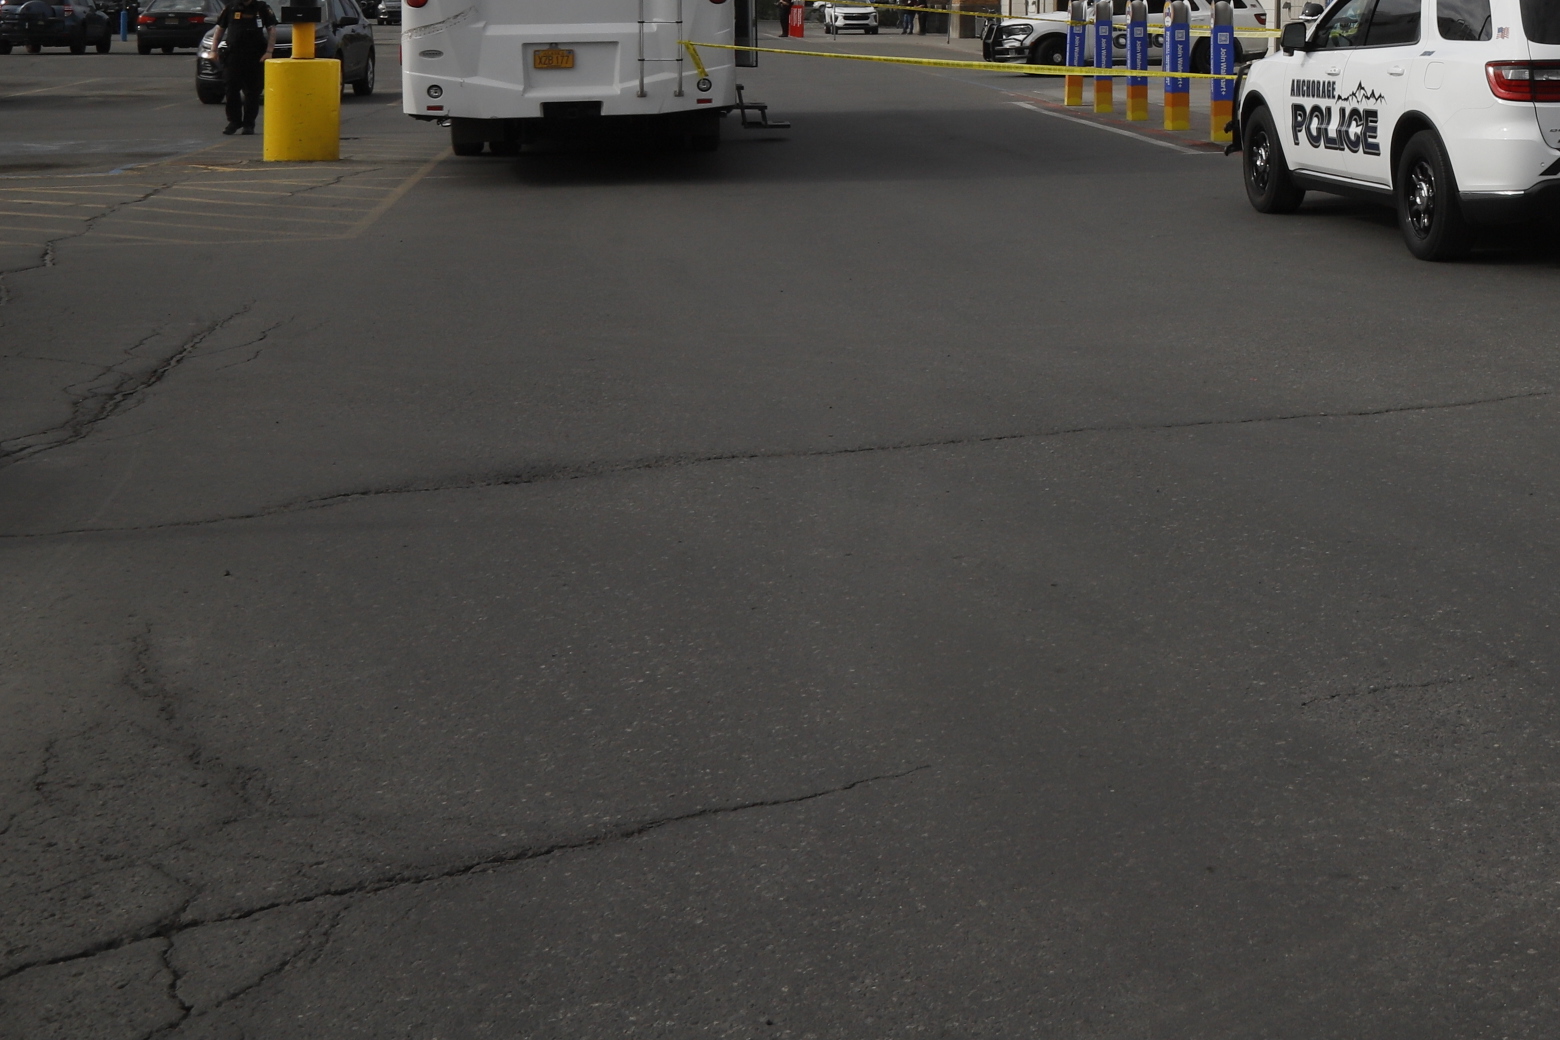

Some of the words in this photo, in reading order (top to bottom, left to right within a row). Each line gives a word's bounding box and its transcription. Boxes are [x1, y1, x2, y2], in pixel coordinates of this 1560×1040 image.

[555, 55, 570, 65] 177
[1290, 78, 1336, 99] ANCHORAGE
[1291, 102, 1381, 156] POLICE
